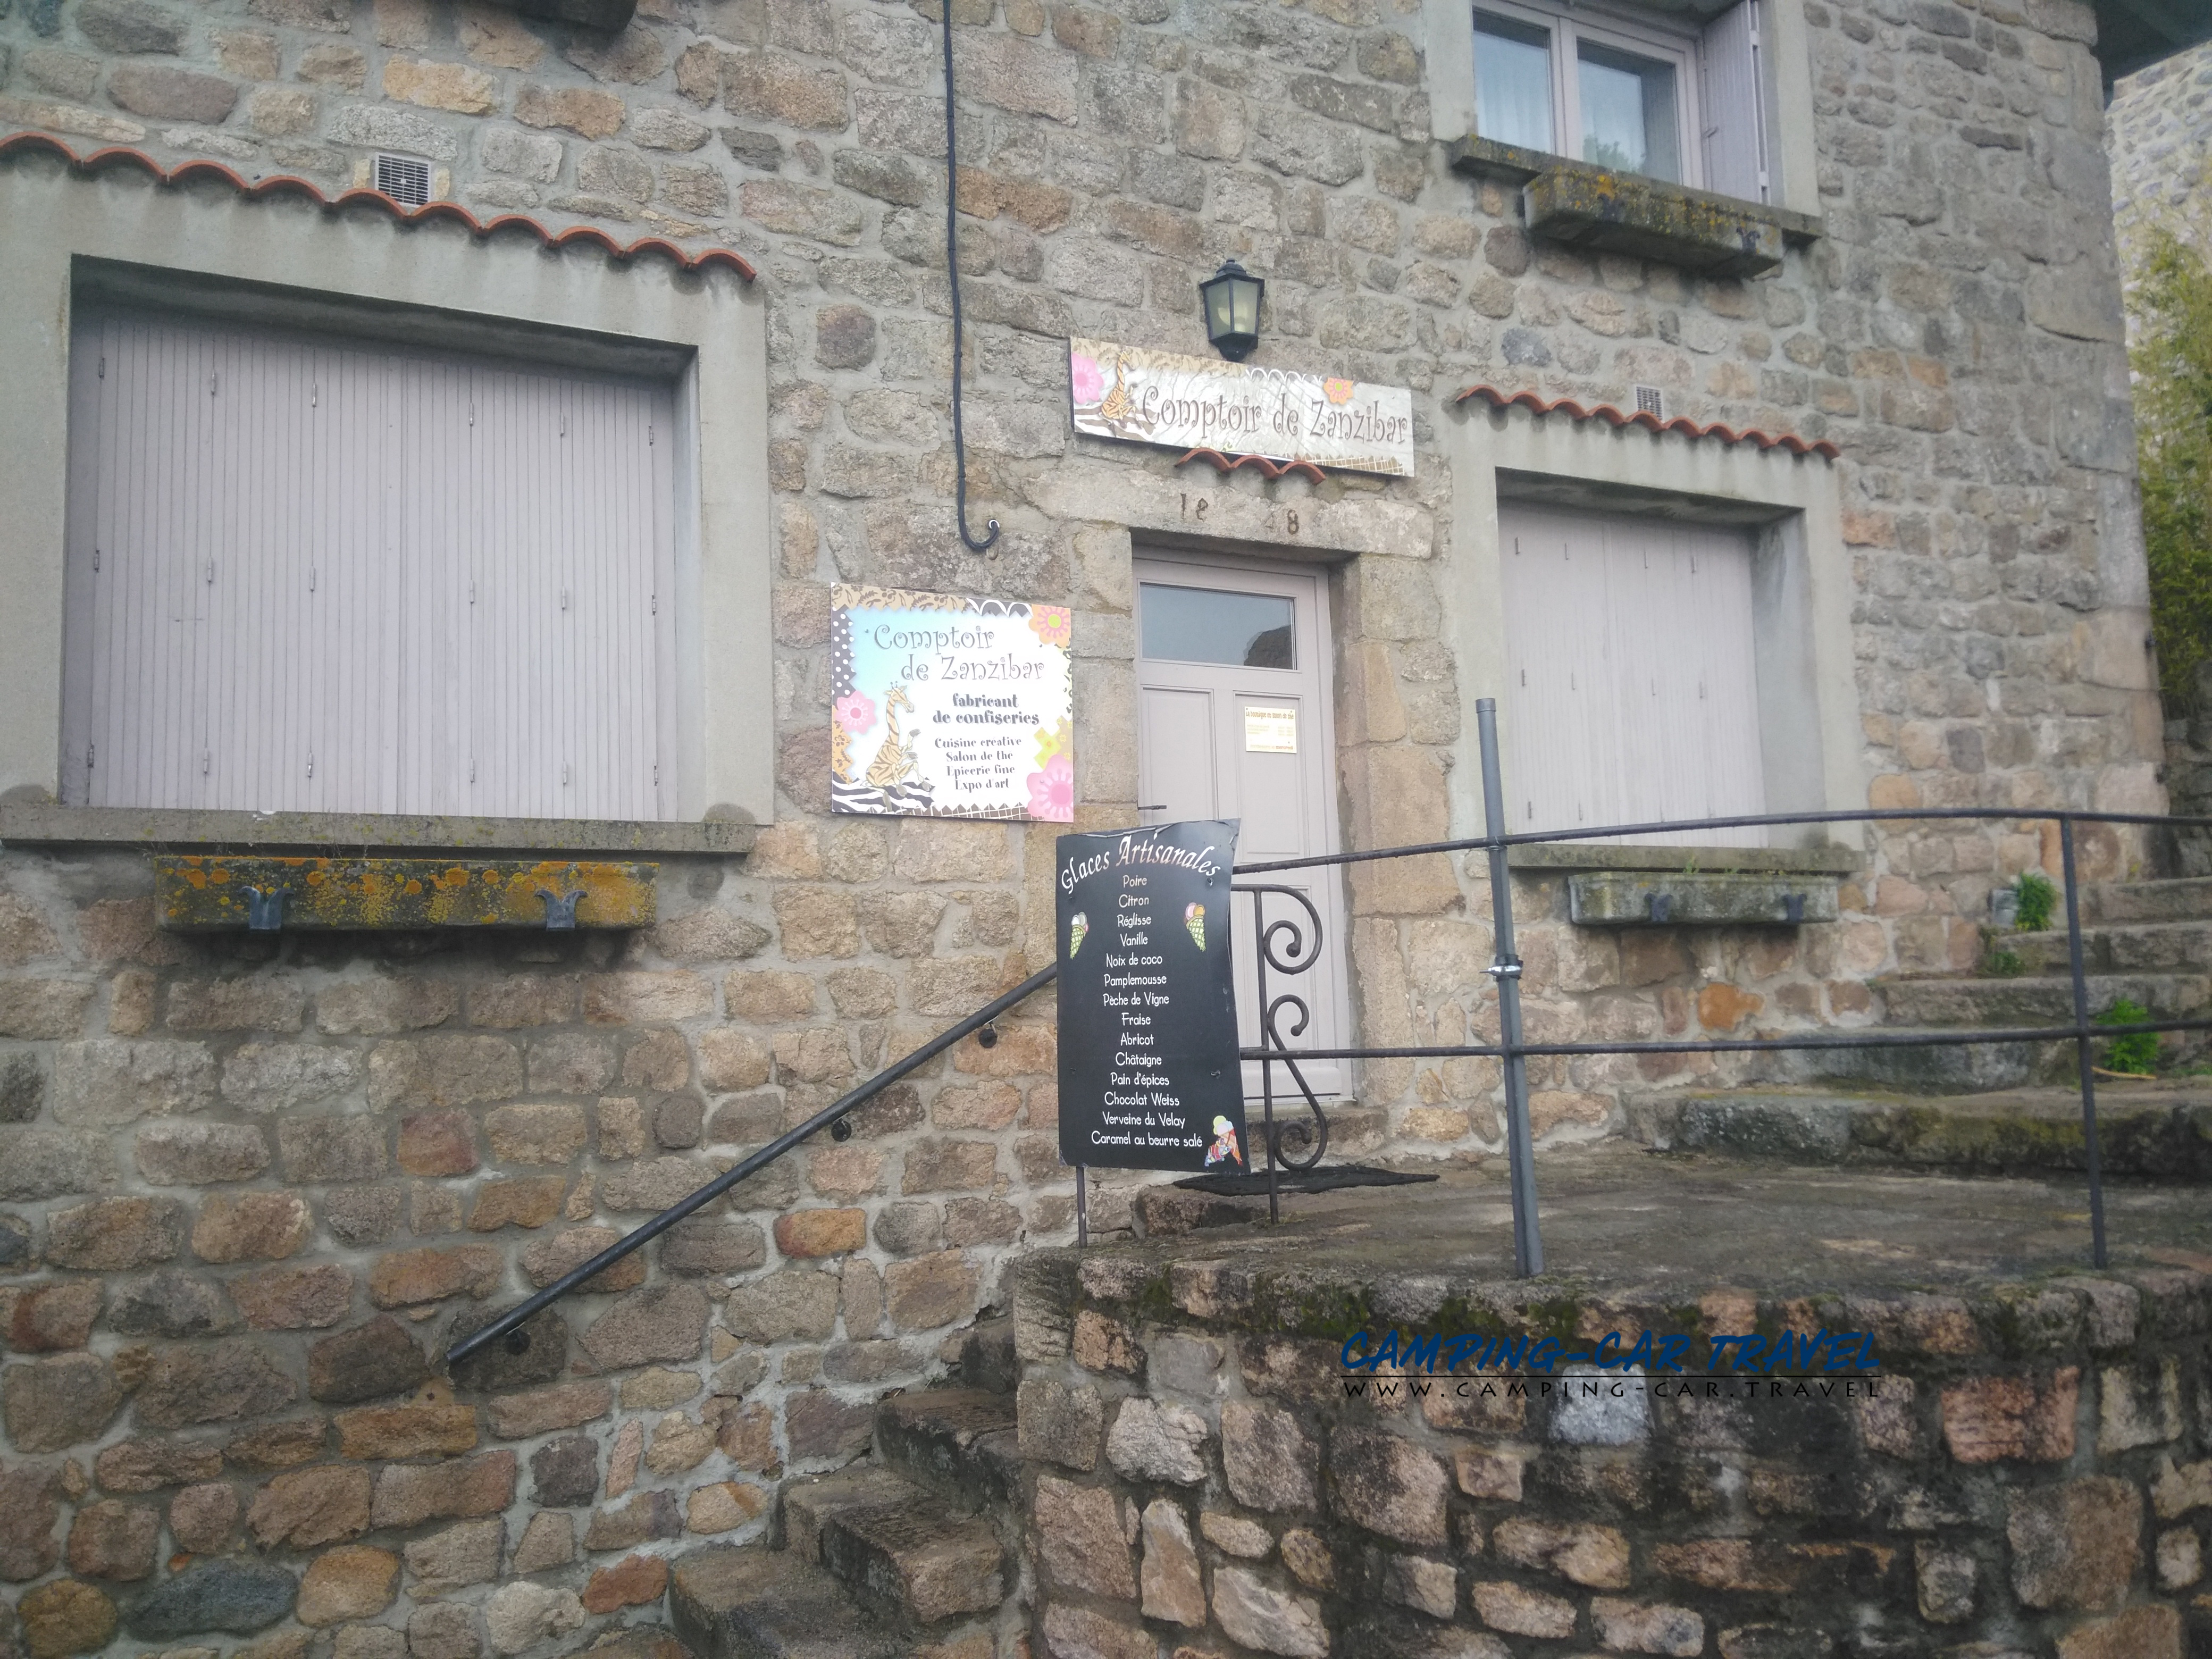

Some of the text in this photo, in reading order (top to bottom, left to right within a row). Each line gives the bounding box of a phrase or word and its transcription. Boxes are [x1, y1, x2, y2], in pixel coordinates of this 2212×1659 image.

[1142, 386, 1408, 445] Comptoir de Zanzibar
[874, 624, 995, 655] Comptoir
[901, 653, 1045, 681] de Zanzibar
[953, 693, 1019, 708] fabricant
[933, 710, 1040, 725] de confiseries
[935, 738, 976, 748] Cuisine
[946, 750, 1013, 762] Salon de thé
[946, 764, 1015, 780] Epicerie fine
[954, 778, 1010, 793] Expo d'art
[1061, 832, 1221, 895] Glaces Artisanales
[1122, 875, 1147, 888] Poire
[1119, 894, 1150, 908] Citron
[1117, 912, 1152, 928] Réglisse
[1120, 932, 1149, 947] Vanille
[1106, 952, 1163, 968] Noix de coco
[1103, 972, 1167, 989] Pamplemousse
[1103, 991, 1169, 1007] Pèche de Vigne
[1121, 1012, 1151, 1026] Fraise
[1120, 1032, 1154, 1046] Abricot
[1116, 1051, 1162, 1068] Châtaigne
[1110, 1071, 1170, 1088] Pain d'épices
[1104, 1091, 1180, 1107] Chocolat Weiss
[1102, 1111, 1185, 1129] Verveine du Velay
[1091, 1130, 1203, 1147] Caramel au beurre salé
